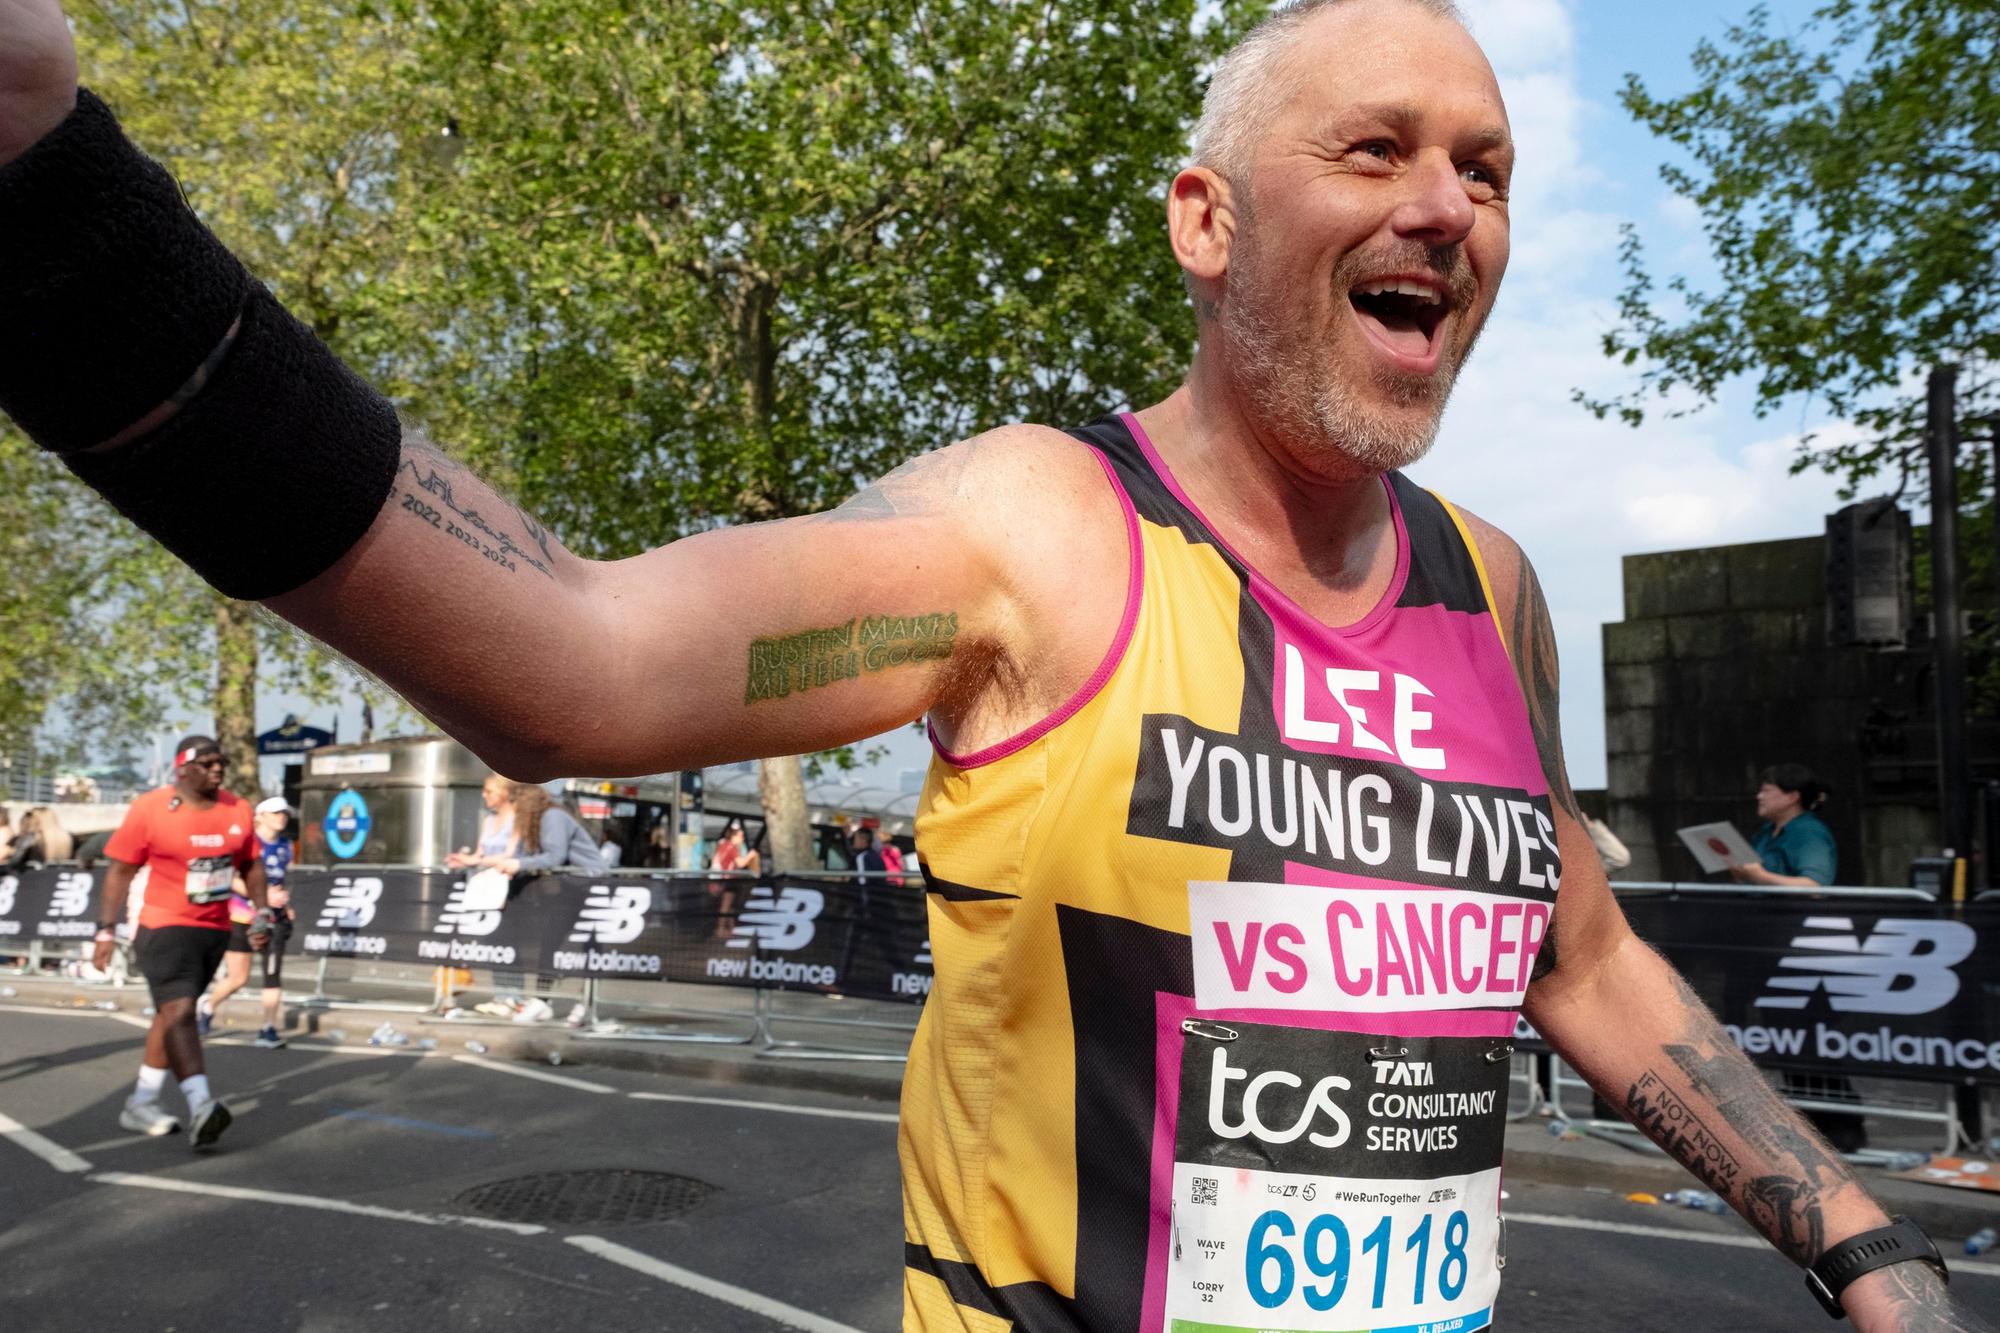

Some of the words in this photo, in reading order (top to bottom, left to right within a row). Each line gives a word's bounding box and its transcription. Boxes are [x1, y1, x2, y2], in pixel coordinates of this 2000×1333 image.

[402, 494, 442, 529] 2022
[446, 521, 480, 550] 2023
[482, 544, 516, 573] 2024
[1285, 644, 1446, 770] LEE
[1161, 729, 1392, 866] YOUNG
[1415, 782, 1561, 891] LIVES
[304, 934, 330, 951] new
[418, 940, 450, 958] new
[451, 938, 516, 964] balance
[1326, 900, 1549, 997] CANCER
[553, 951, 588, 970] new
[588, 948, 661, 973] balance
[706, 957, 747, 977] new
[750, 955, 836, 985] balance
[1371, 1060, 1434, 1086] TATA
[1208, 1046, 1351, 1148] tcs
[1368, 1090, 1496, 1119] CONSULTANCY
[1638, 1072, 1656, 1089] IF
[1656, 1091, 1694, 1130] NOT
[1366, 1125, 1458, 1152] SERVICES
[1335, 1191, 1421, 1206] #WeRunTogether
[1197, 1239, 1225, 1250] WAVE
[1204, 1251, 1216, 1260] 17
[1245, 1209, 1470, 1312] 69118
[1192, 1281, 1225, 1292] LORRY
[1201, 1294, 1214, 1303] 32
[1432, 1319, 1464, 1333] RELAXED
